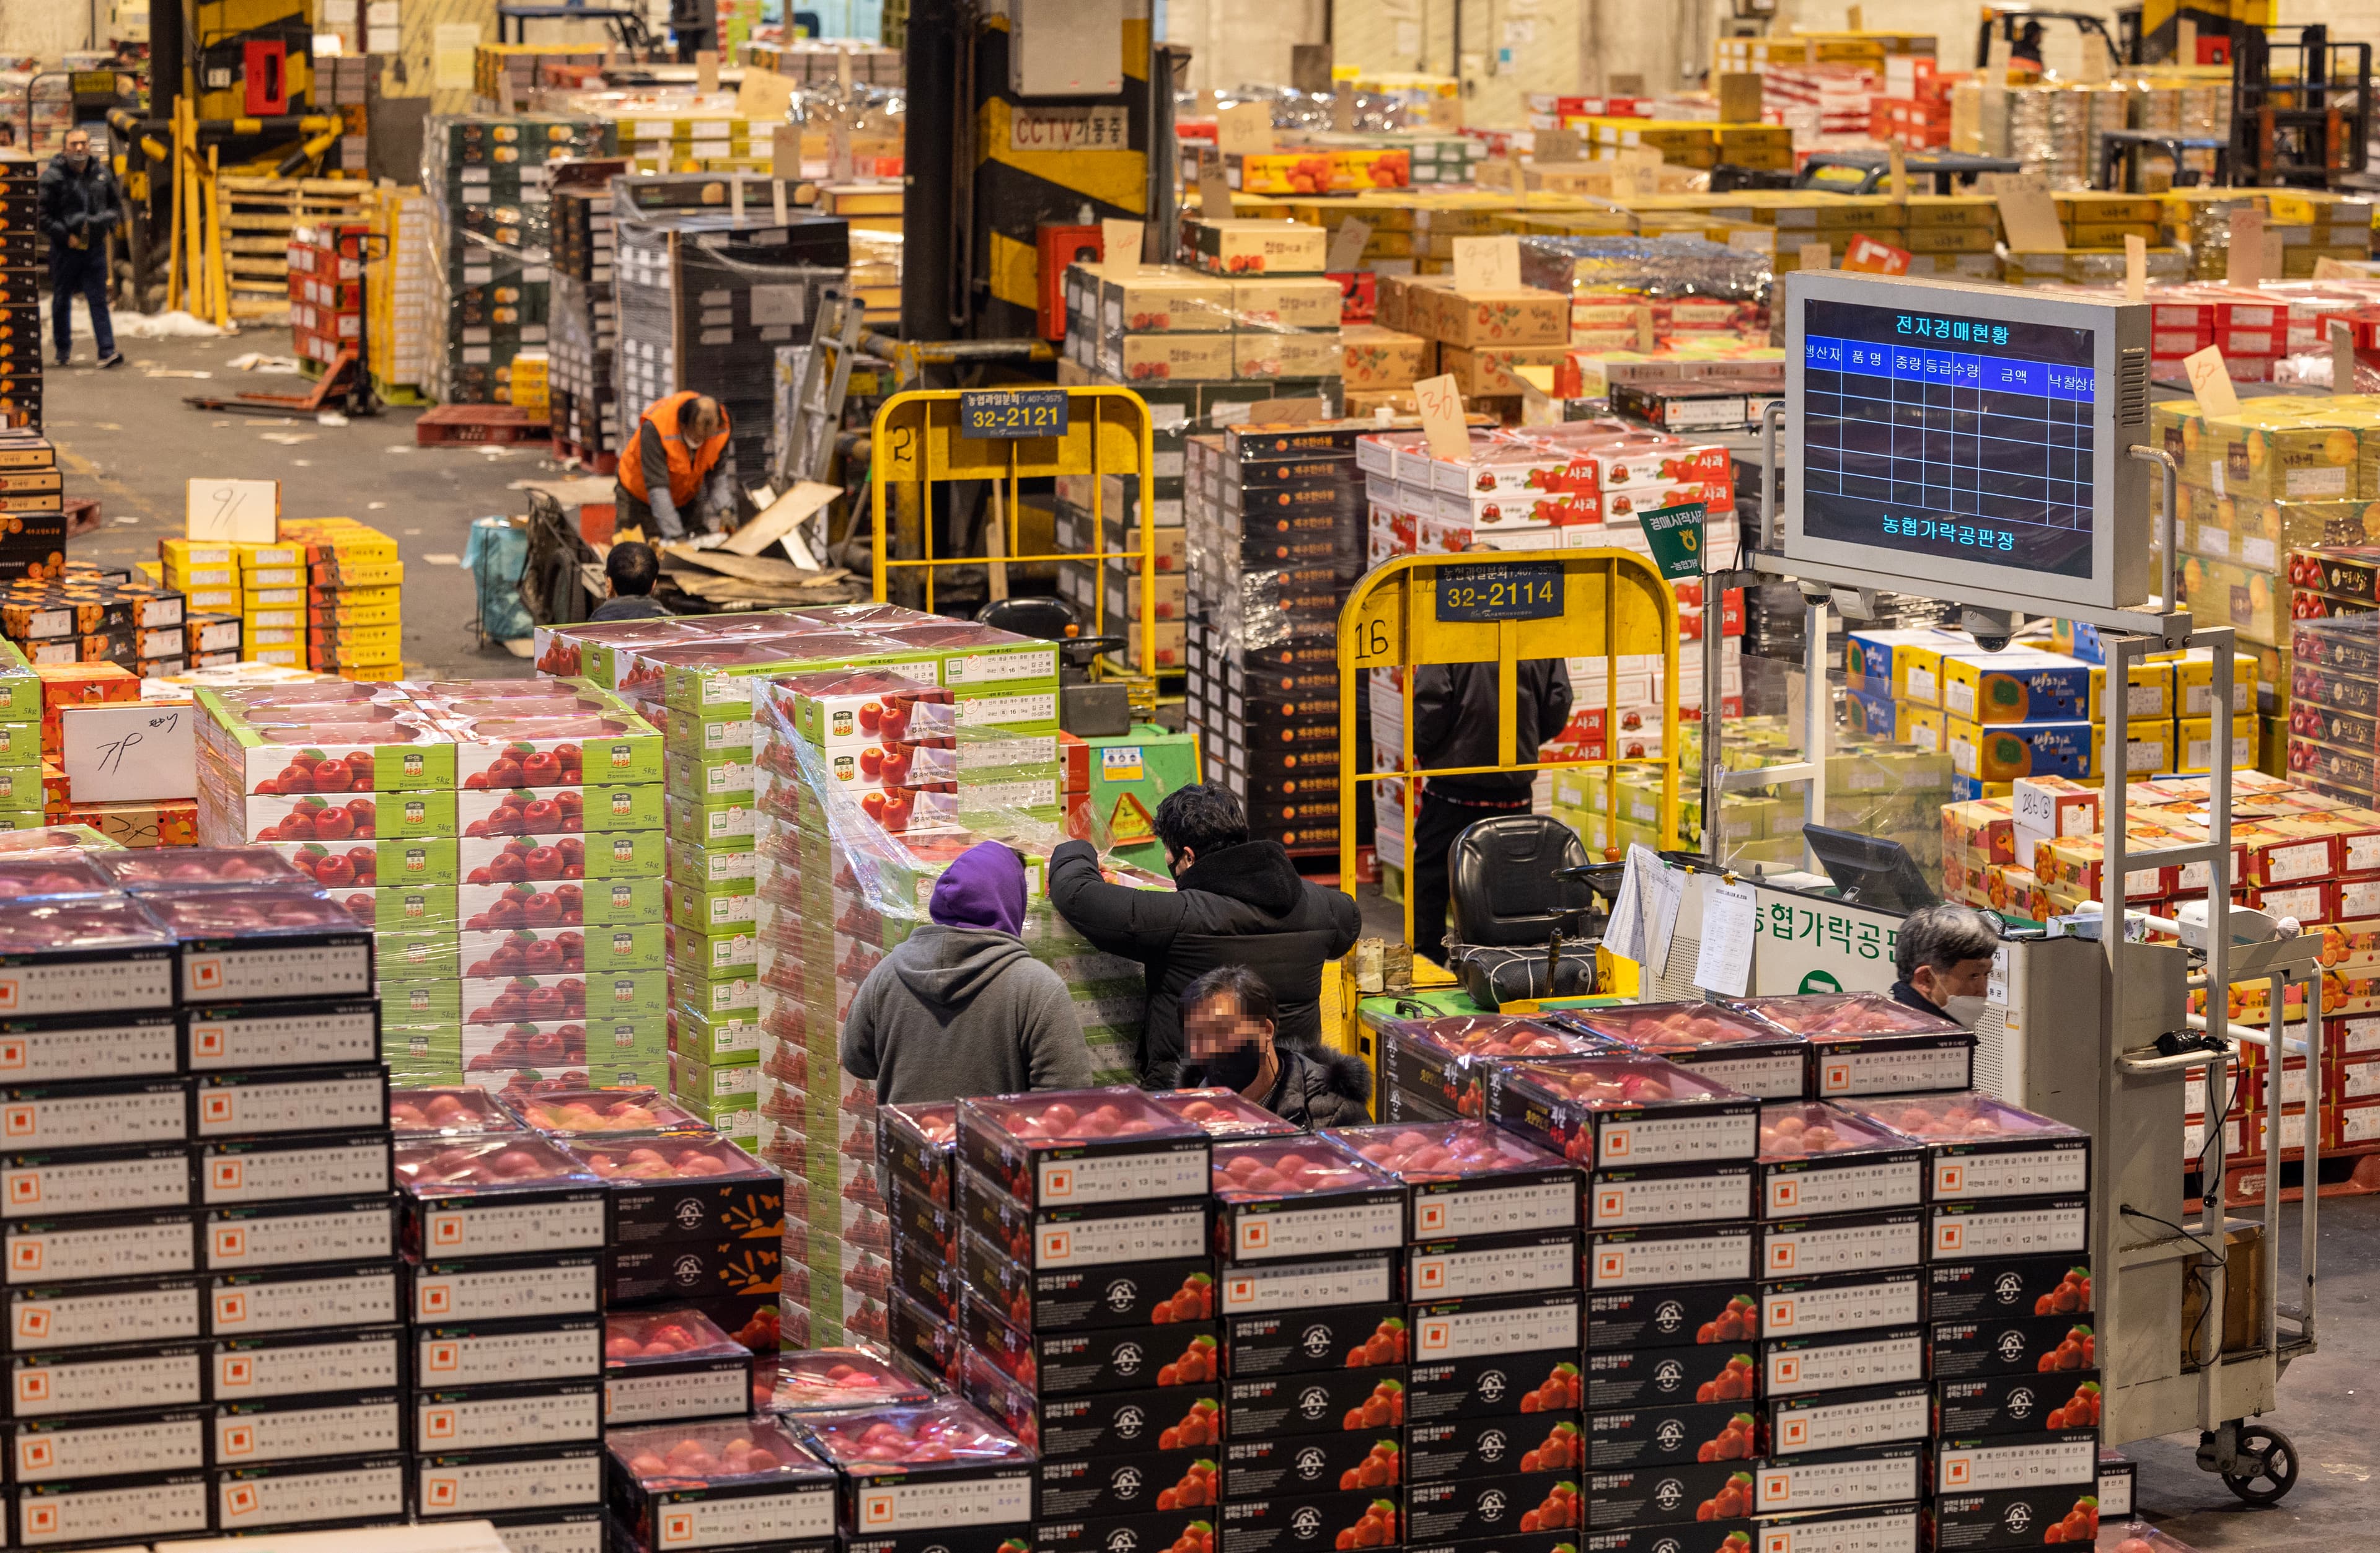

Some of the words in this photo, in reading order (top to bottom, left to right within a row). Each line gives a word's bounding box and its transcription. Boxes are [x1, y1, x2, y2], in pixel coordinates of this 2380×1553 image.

[1896, 314, 2009, 345] 전자경매현황
[1805, 344, 1841, 362] 생산자
[1896, 355, 1921, 371] 중량
[1926, 358, 1952, 375] 등급
[1954, 361, 1979, 378] 수량
[2001, 367, 2027, 385] 금액
[1422, 377, 1453, 421] 36
[972, 407, 1057, 428] 32-2121
[892, 426, 912, 462] 2
[1700, 454, 1724, 470] 사과
[1569, 465, 1593, 480] 사과
[1703, 486, 1727, 501] 사과
[1573, 497, 1597, 512] 사과
[1882, 513, 2014, 551] 농협가락공판장
[1447, 581, 1553, 607] 32-2114
[1723, 610, 1736, 624] 과
[1355, 619, 1388, 659] 16
[23, 707, 37, 715] 5kg
[1576, 715, 1600, 729] 사과
[22, 752, 36, 760] 5kg
[1578, 746, 1601, 759] 사과
[642, 767, 657, 775] 5kg
[643, 815, 658, 823] 5kg
[436, 824, 451, 832] 5kg
[645, 861, 659, 869] 5kg
[437, 871, 452, 879] 5kg
[643, 907, 657, 916] 5kg
[644, 954, 659, 962] 5kg
[438, 964, 453, 973] 5kg
[645, 1001, 660, 1010] 5kg
[645, 1047, 660, 1055] 5kg
